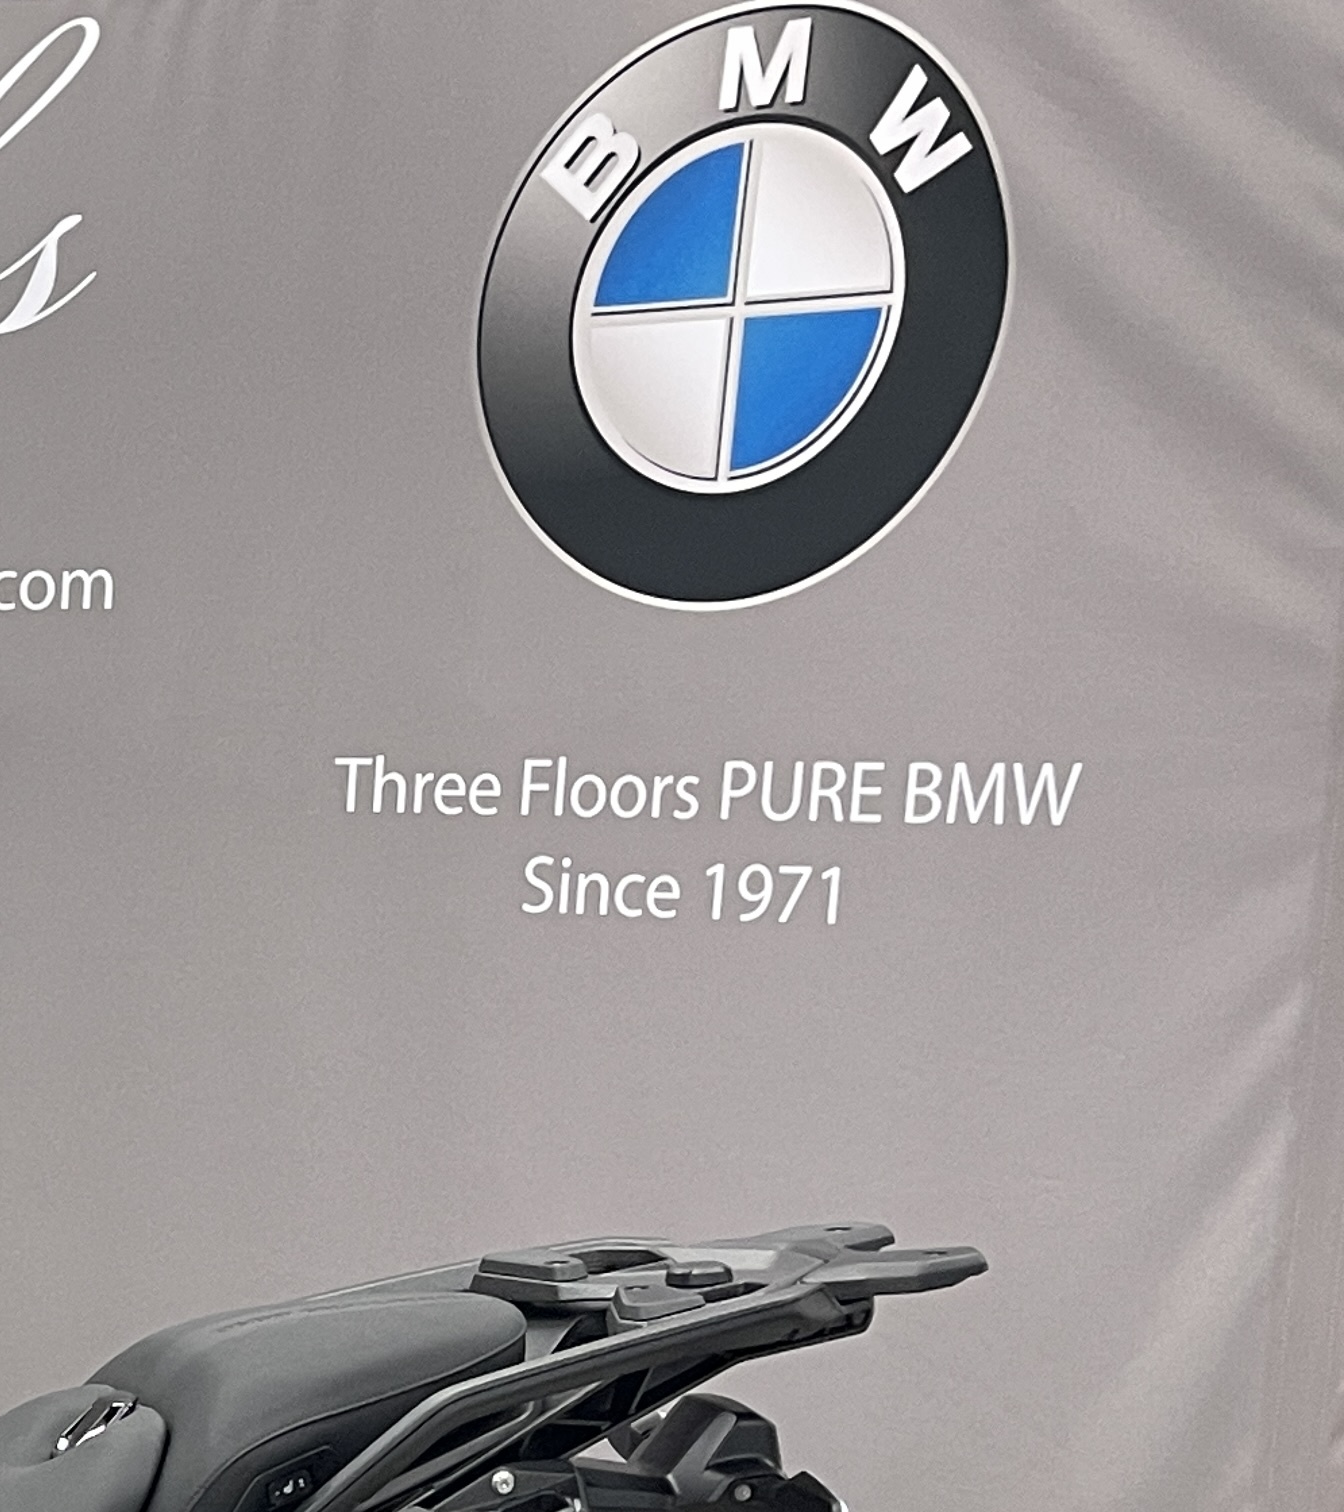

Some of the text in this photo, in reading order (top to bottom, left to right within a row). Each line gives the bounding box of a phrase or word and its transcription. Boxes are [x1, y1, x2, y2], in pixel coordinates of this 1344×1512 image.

[539, 16, 973, 222] BMW
[334, 754, 1083, 826] Three Floors PURE BMW
[521, 855, 841, 925] Since 1971
